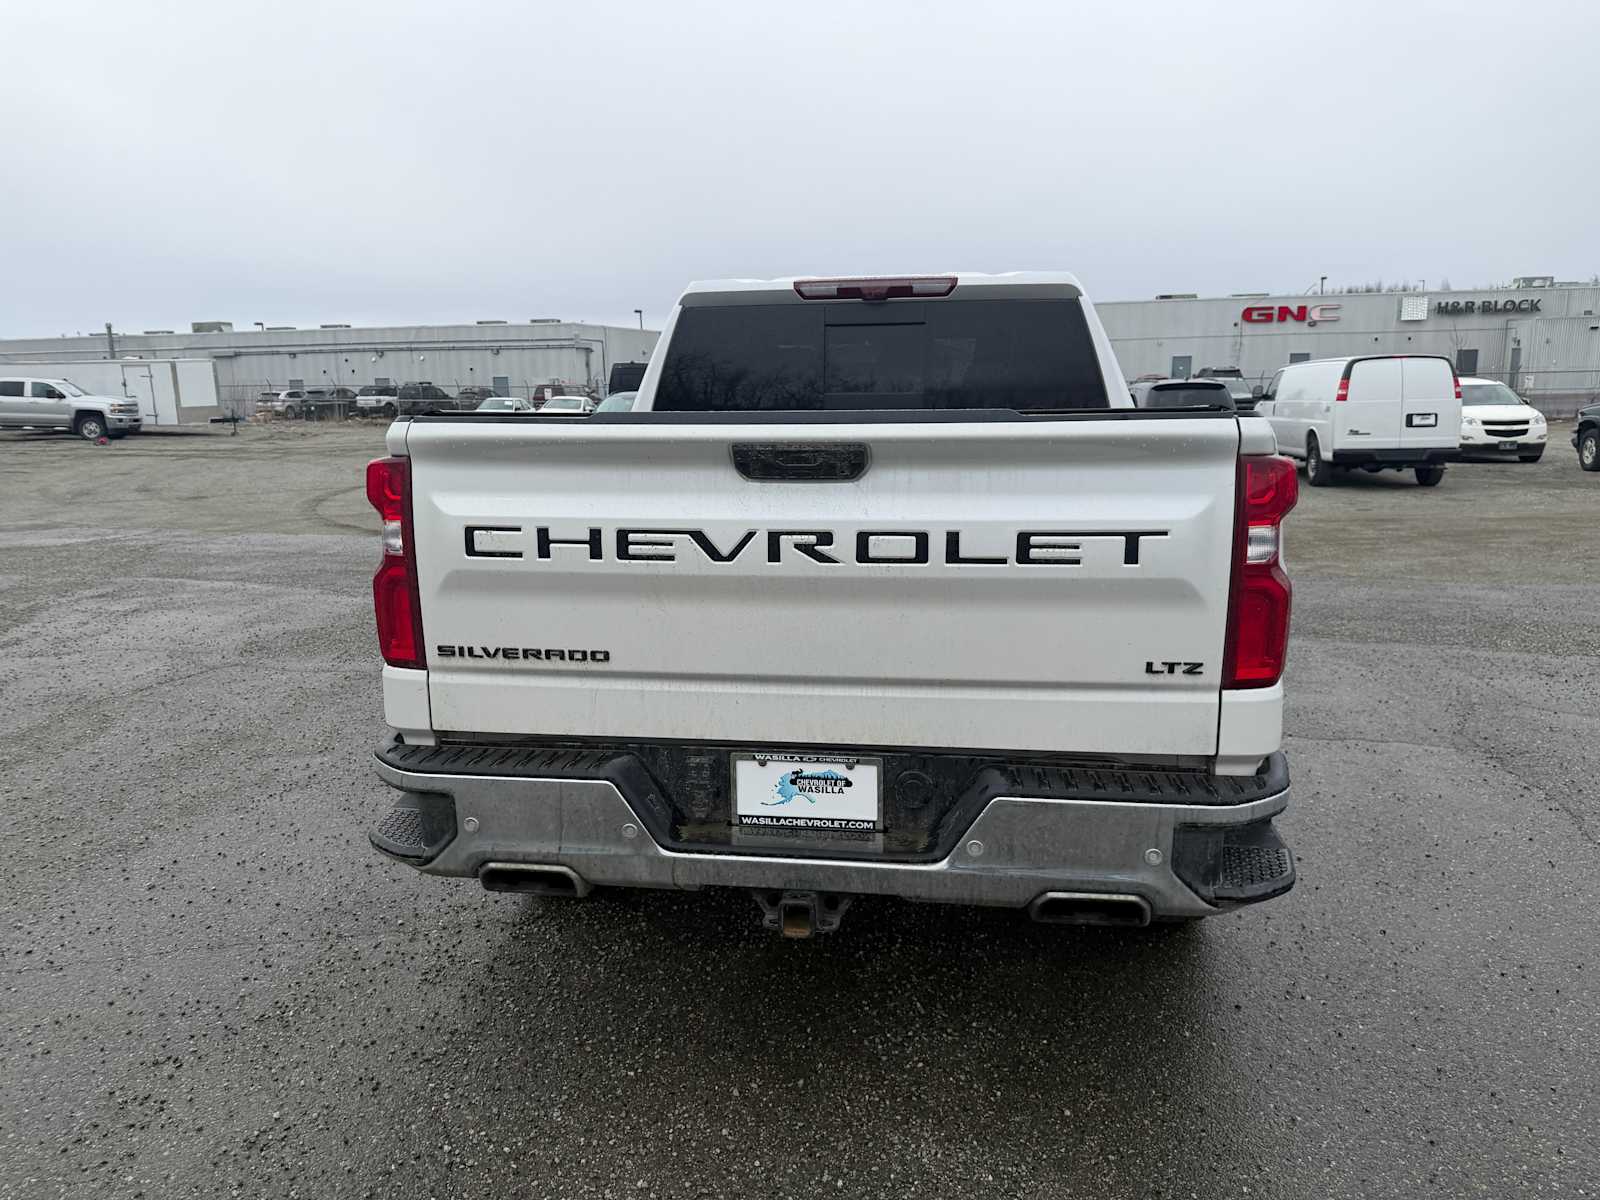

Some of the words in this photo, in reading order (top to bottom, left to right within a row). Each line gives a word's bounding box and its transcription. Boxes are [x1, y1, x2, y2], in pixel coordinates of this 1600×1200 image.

[1241, 304, 1342, 323] GNC
[1437, 301, 1475, 314] H&R
[1481, 299, 1541, 313] BLOCK
[465, 526, 1168, 565] CHEVROLET
[437, 645, 610, 663] SILVERADO
[1145, 661, 1204, 676] LTZ
[754, 754, 801, 762] WASILLA
[796, 779, 835, 787] CHEVROLET
[798, 786, 845, 794] WASILLA
[741, 817, 874, 829] WASILLACHEVROLET.COM
